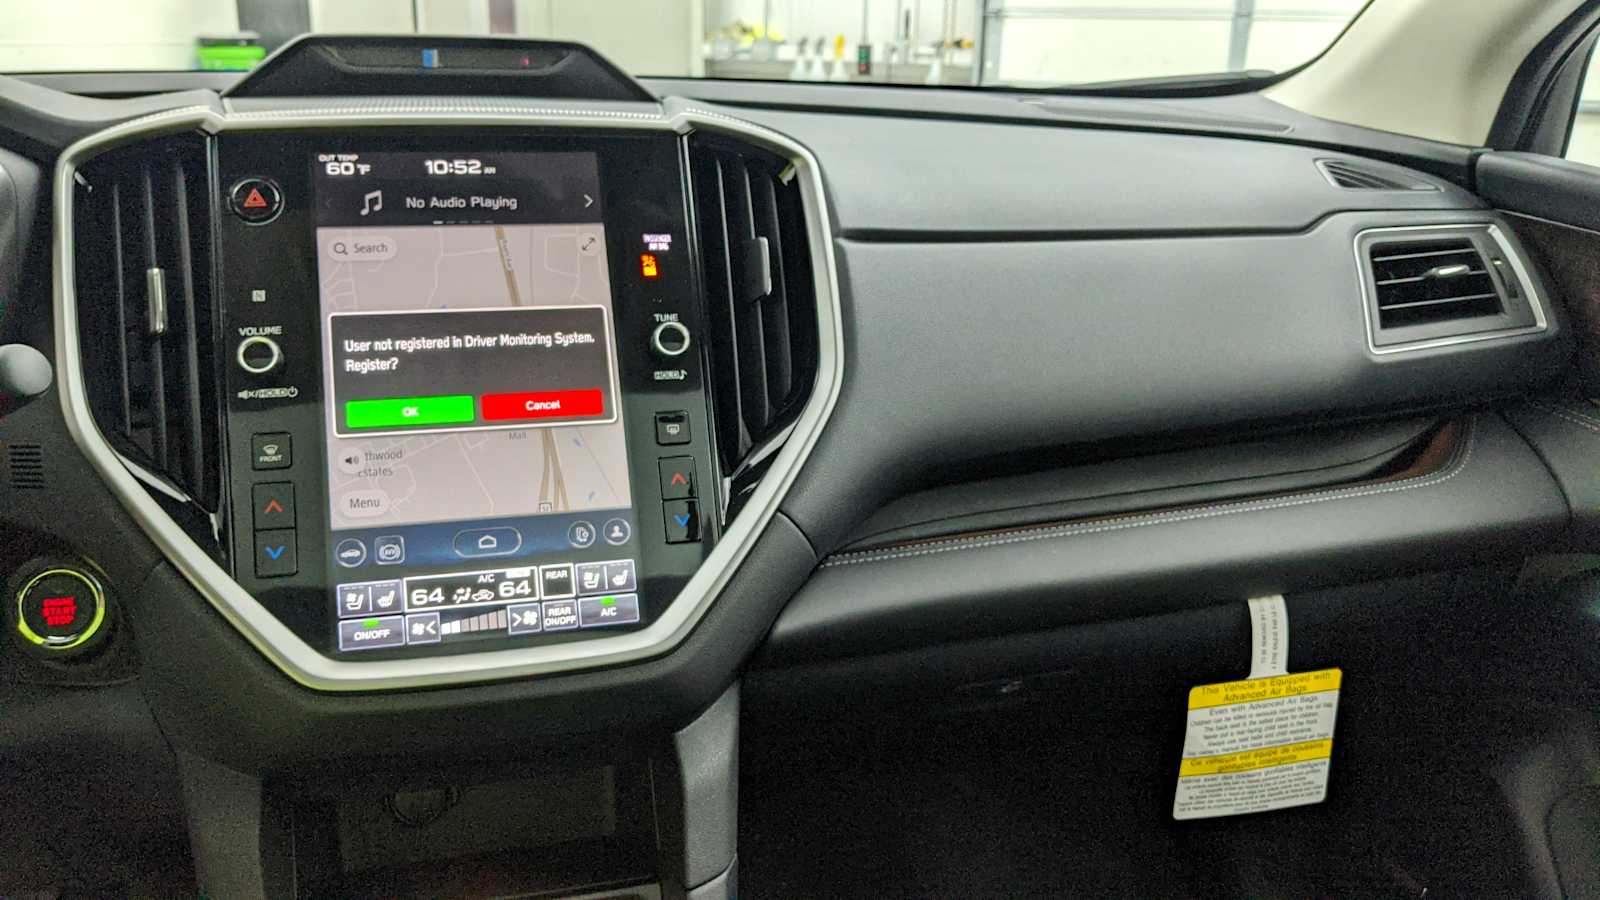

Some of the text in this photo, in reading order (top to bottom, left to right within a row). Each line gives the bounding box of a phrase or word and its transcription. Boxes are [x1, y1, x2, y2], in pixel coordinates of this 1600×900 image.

[325, 162, 355, 175] 60
[424, 160, 482, 175] 10:52
[406, 196, 517, 210] No Audio Playing
[354, 243, 388, 254] Search
[654, 313, 679, 322] TUNE
[239, 326, 282, 336] VOLUME
[344, 332, 595, 352] User not registered in Driver Monitoring System.
[345, 359, 398, 374] Register?
[402, 400, 561, 417] OK Cancel
[509, 432, 526, 440] Mall
[350, 498, 380, 509] Menu
[478, 574, 495, 583] A/C
[546, 570, 568, 579] REAR
[412, 581, 531, 605] 64 64
[548, 607, 571, 616] REAR
[601, 607, 617, 617] A/C
[545, 615, 577, 626] ON/OFF
[354, 629, 390, 640] ON/OFF
[1202, 687, 1219, 695] This
[1224, 681, 1256, 691] Vehicle
[1270, 675, 1311, 687] Equipped
[1313, 672, 1330, 680] with
[1224, 685, 1307, 701] Advanced Air Bags
[1250, 700, 1284, 710] Advanced
